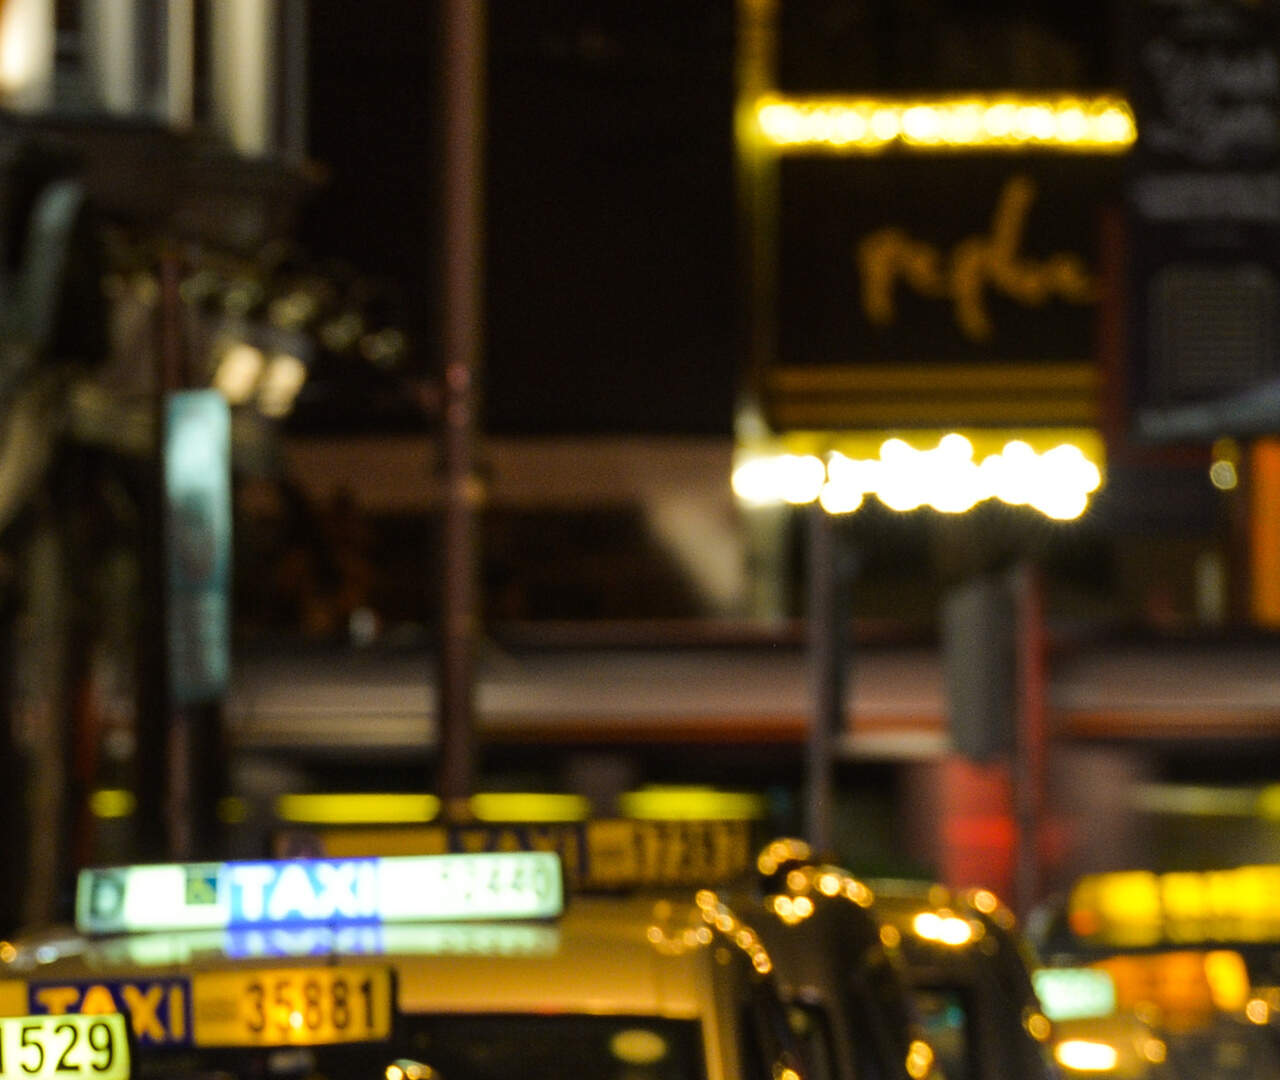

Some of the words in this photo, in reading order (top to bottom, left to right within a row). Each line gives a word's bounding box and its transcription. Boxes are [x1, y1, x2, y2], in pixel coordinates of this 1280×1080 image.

[229, 863, 378, 920] TAXI
[37, 984, 185, 1041] TAXI
[247, 979, 374, 1033] 35881
